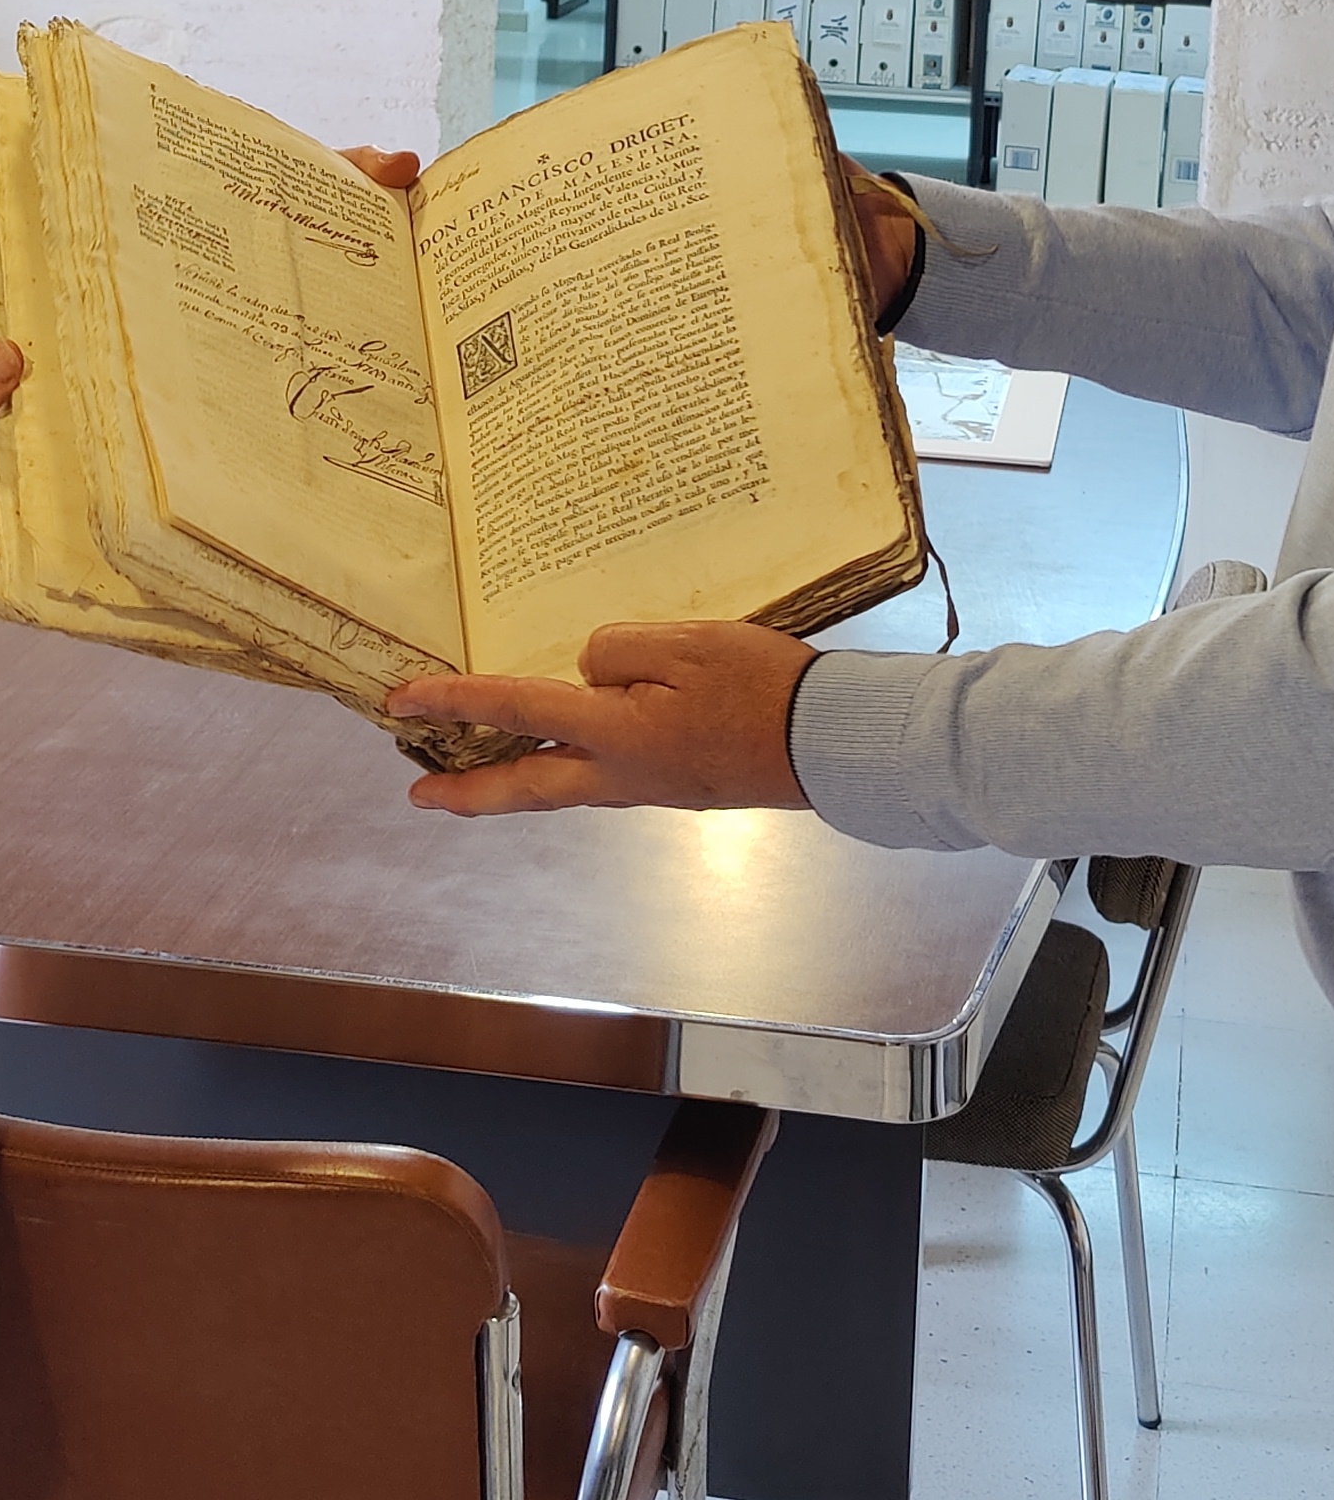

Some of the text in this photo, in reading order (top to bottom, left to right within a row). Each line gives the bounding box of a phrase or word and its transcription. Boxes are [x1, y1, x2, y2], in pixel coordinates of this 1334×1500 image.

[419, 217, 456, 256] DON
[468, 151, 592, 220] FRANCISCO
[433, 209, 505, 263] MARQUES
[520, 188, 544, 208] DE
[435, 257, 449, 274] del
[489, 226, 501, 238] de
[573, 169, 632, 198] Intendente
[636, 160, 650, 172] de
[538, 248, 551, 263] de
[552, 244, 567, 256] las
[568, 214, 646, 249] Generalidades
[649, 206, 664, 217] de
[560, 208, 596, 226] mayor
[599, 200, 612, 211] de
[606, 209, 620, 221] de
[444, 251, 477, 284] general
[478, 242, 494, 258] del
[588, 192, 601, 204] de
[675, 297, 687, 307] de
